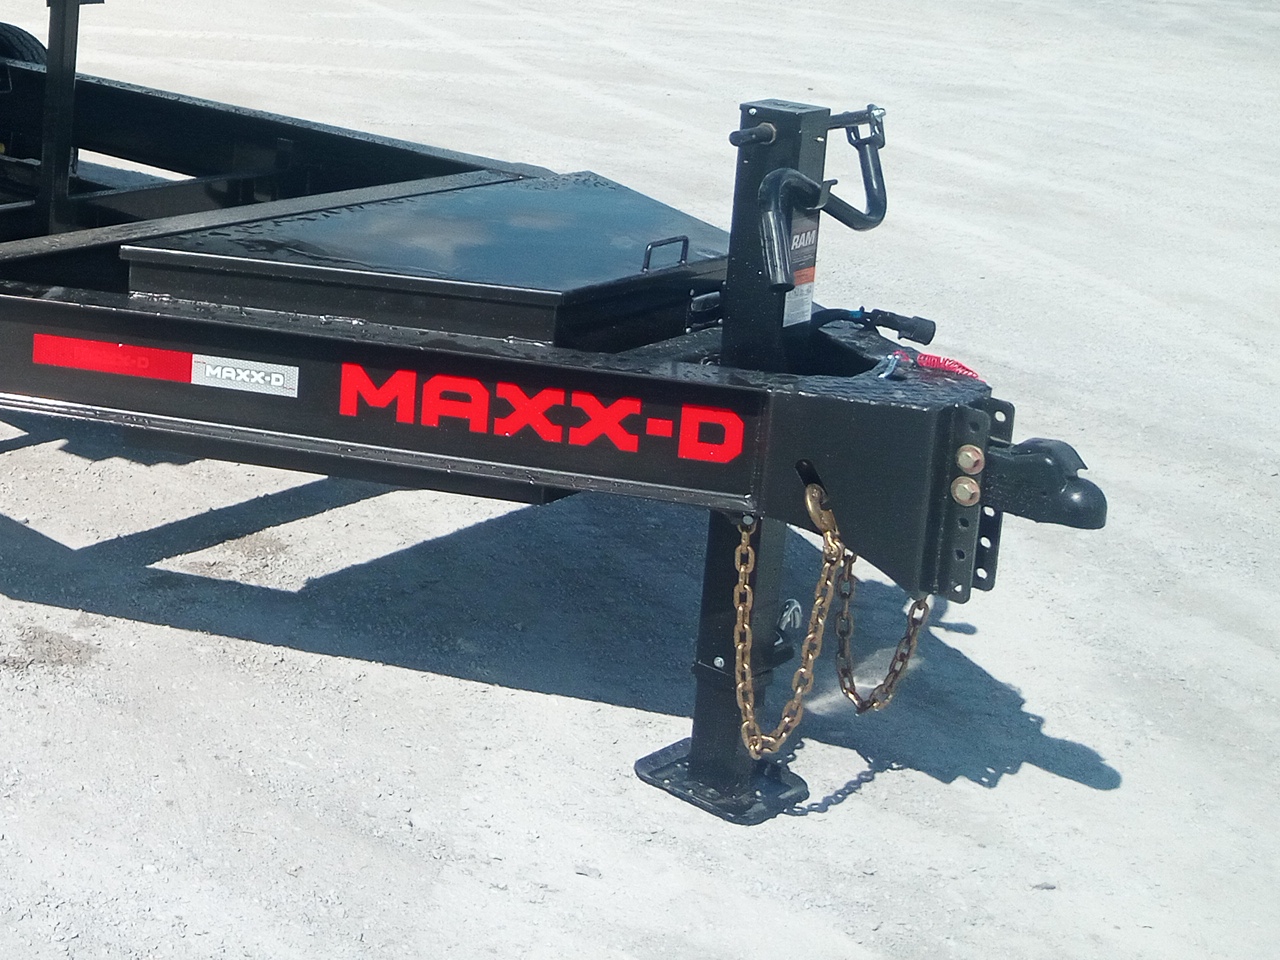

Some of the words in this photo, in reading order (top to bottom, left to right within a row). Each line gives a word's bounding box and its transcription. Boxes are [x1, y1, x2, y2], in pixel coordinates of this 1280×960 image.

[791, 229, 817, 251] RAM
[204, 364, 285, 388] MAXX-D
[338, 361, 745, 464] MAXX-D
